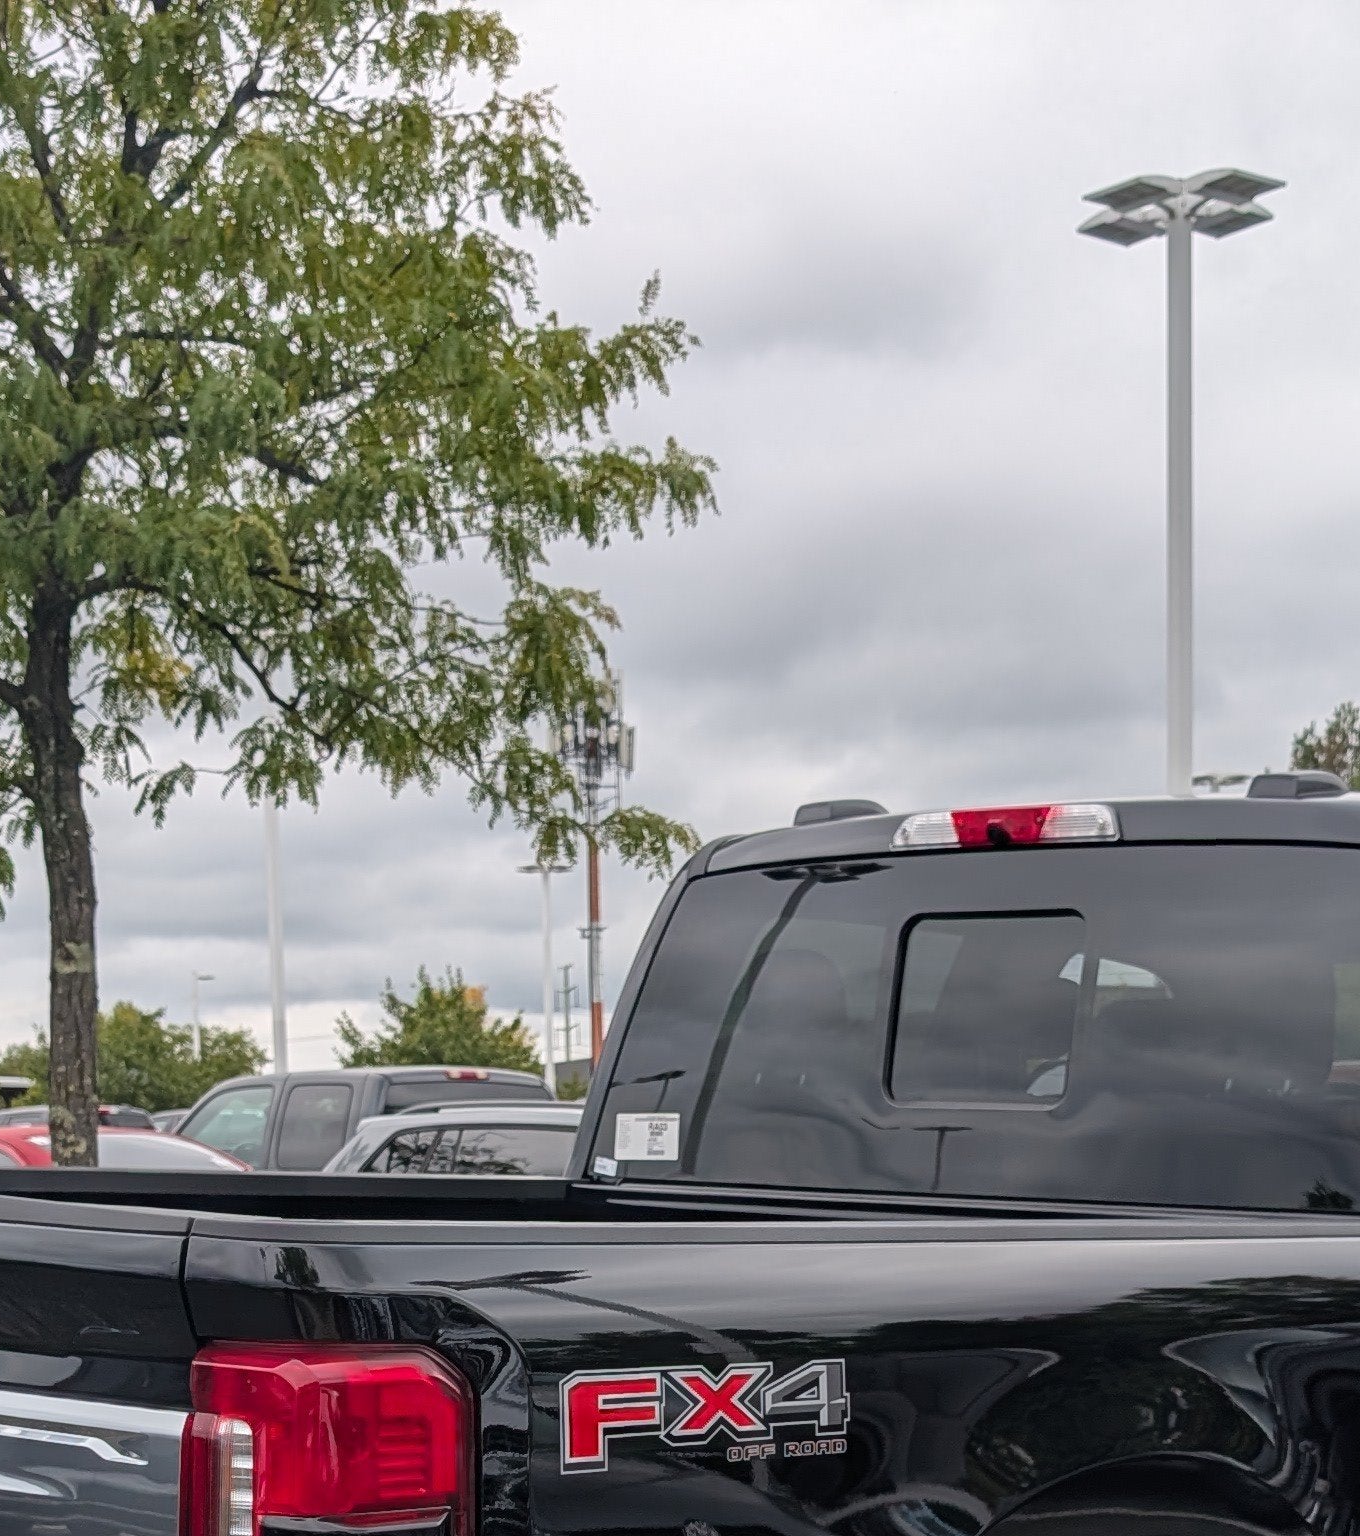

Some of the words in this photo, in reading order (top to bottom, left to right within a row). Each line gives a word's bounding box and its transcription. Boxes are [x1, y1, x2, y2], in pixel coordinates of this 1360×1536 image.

[559, 1359, 850, 1475] FX4
[726, 1444, 776, 1463] OFF
[783, 1438, 847, 1458] ROAD
